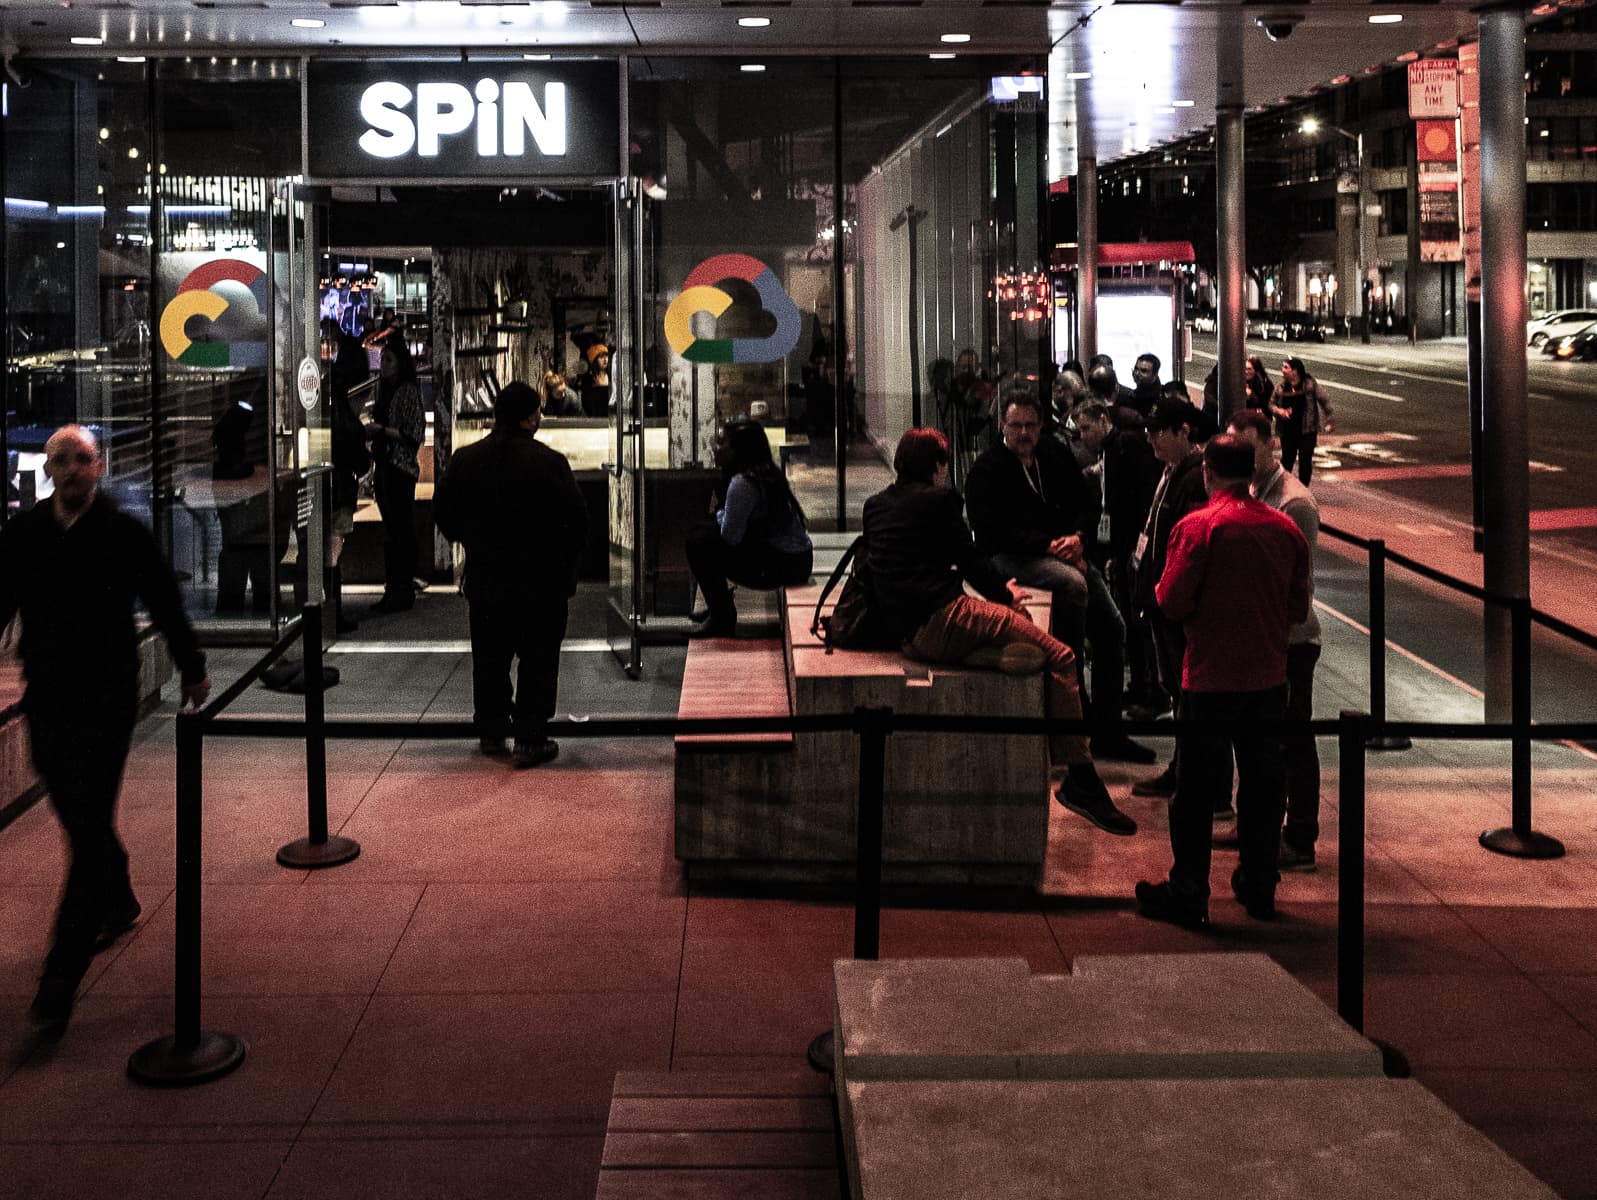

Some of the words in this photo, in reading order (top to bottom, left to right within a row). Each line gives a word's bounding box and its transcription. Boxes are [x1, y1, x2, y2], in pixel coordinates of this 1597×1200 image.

[1410, 70, 1423, 81] NO
[1425, 71, 1455, 81] STOPPING
[1424, 85, 1442, 94] ANY
[1424, 97, 1443, 105] TIME
